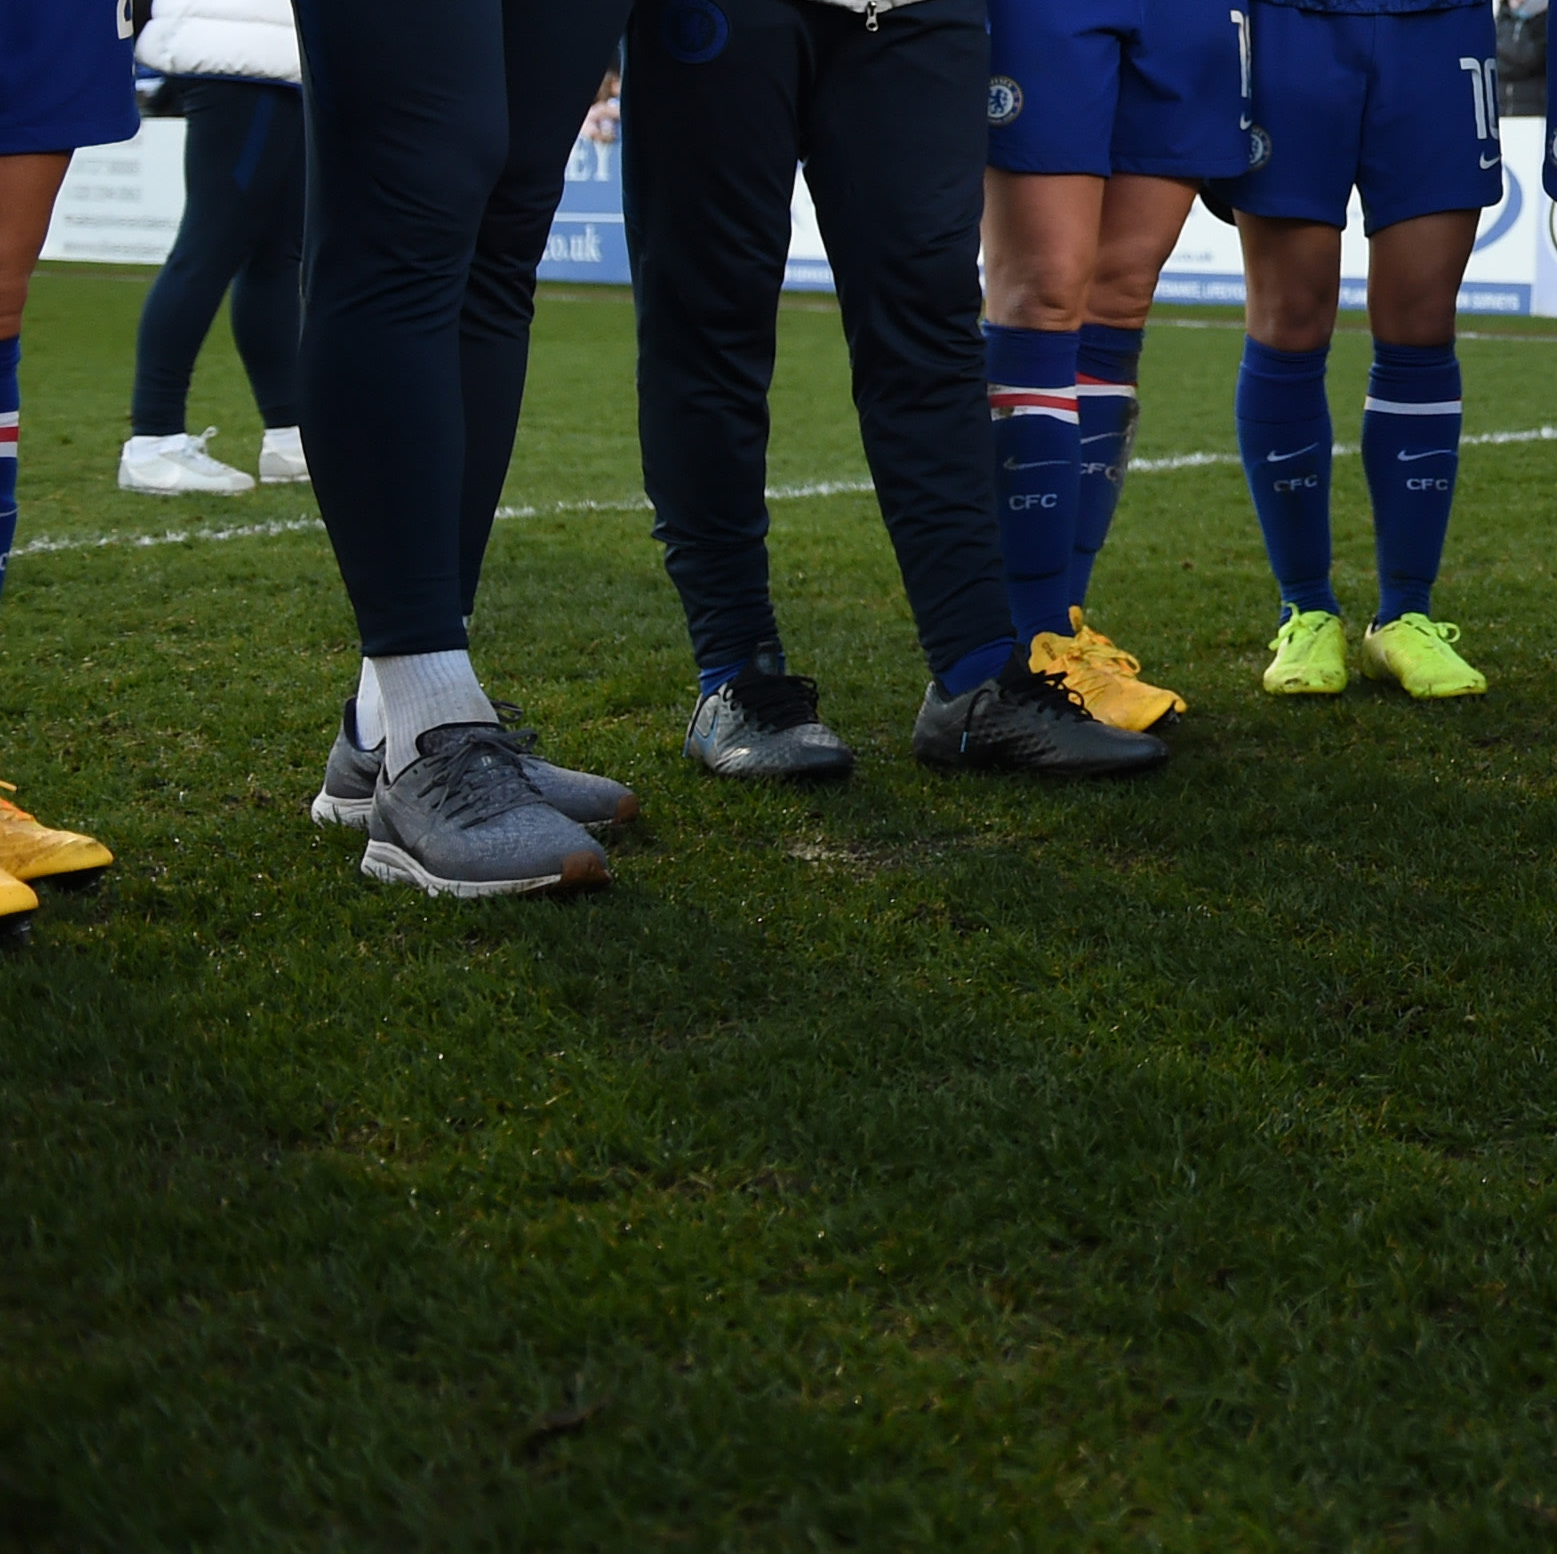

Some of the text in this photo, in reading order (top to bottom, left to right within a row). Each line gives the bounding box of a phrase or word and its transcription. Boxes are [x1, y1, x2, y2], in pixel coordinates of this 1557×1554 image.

[1229, 8, 1252, 100] 1
[1272, 474, 1318, 493] CFC
[1405, 477, 1449, 492] CFC
[1008, 493, 1058, 511] CFC
